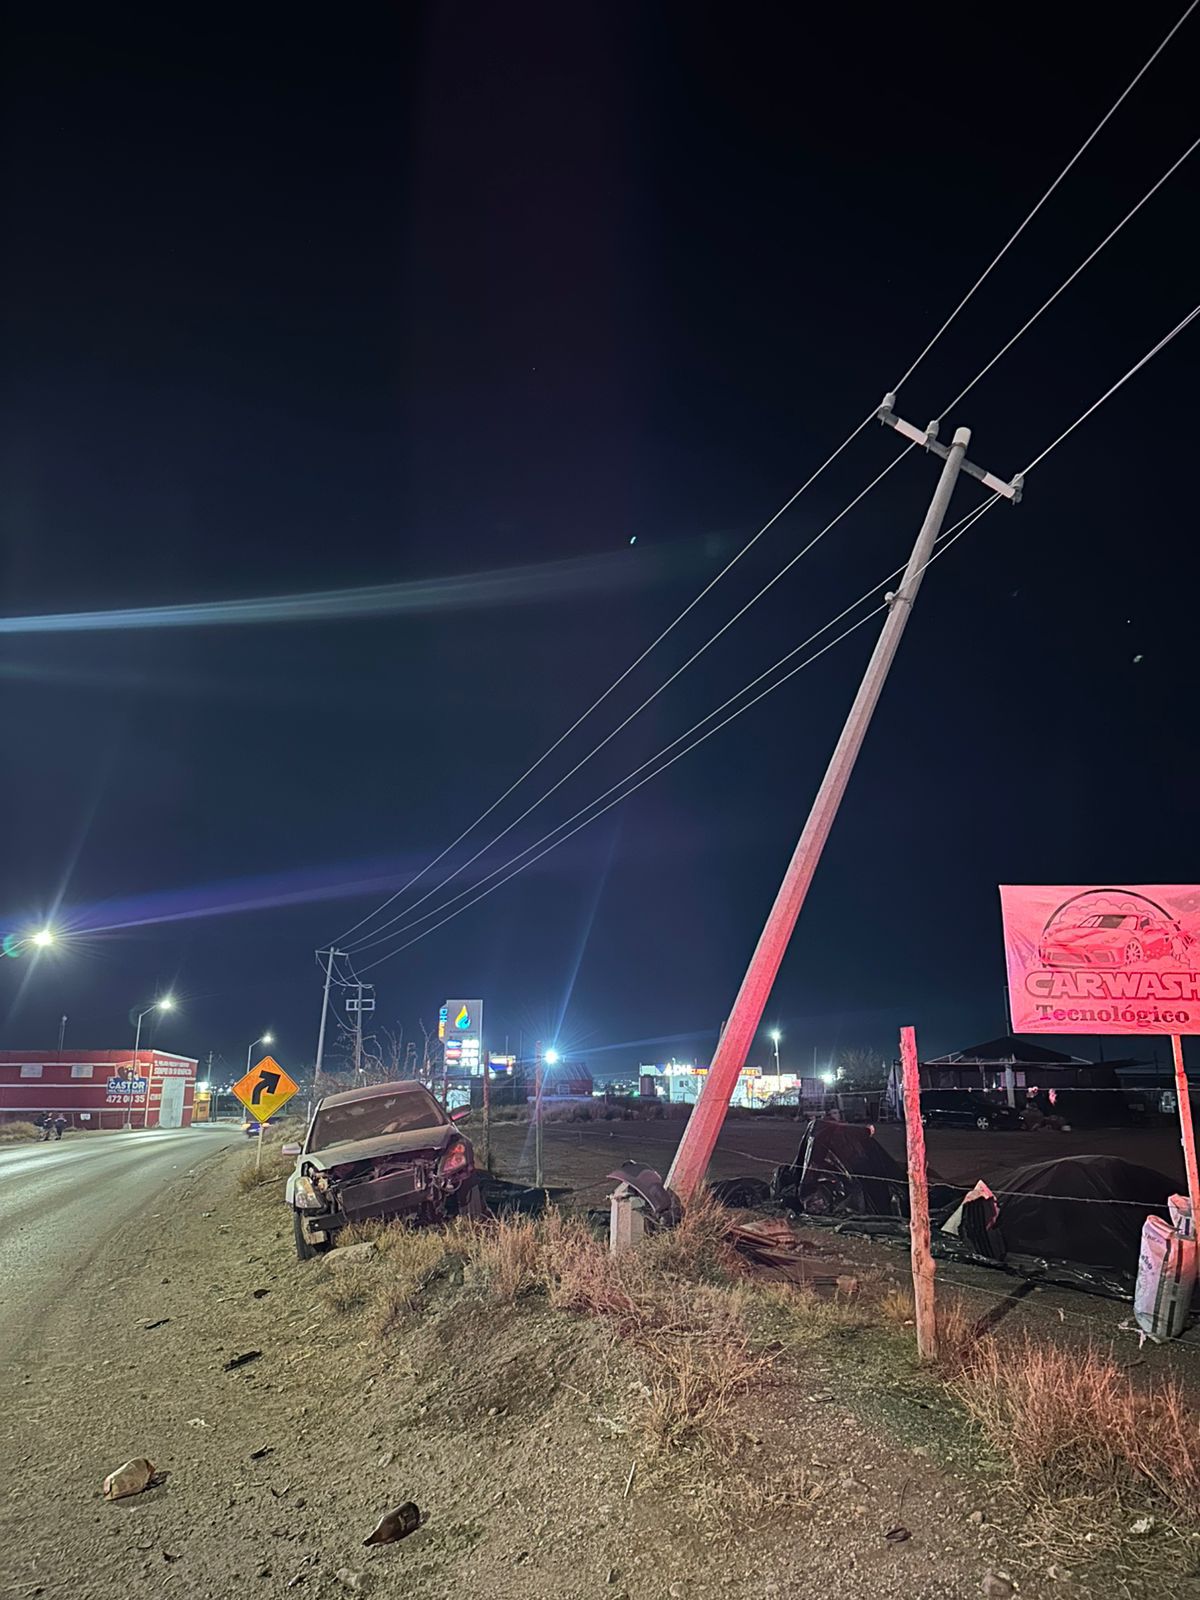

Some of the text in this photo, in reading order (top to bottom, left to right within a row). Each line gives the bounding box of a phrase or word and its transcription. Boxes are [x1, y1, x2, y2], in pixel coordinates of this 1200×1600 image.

[1025, 972, 1200, 1001] CARWASH
[1036, 1004, 1190, 1027] Tecnológico
[109, 1081, 145, 1089] CASTOR
[106, 1094, 121, 1103] 472
[134, 1094, 145, 1103] 35
